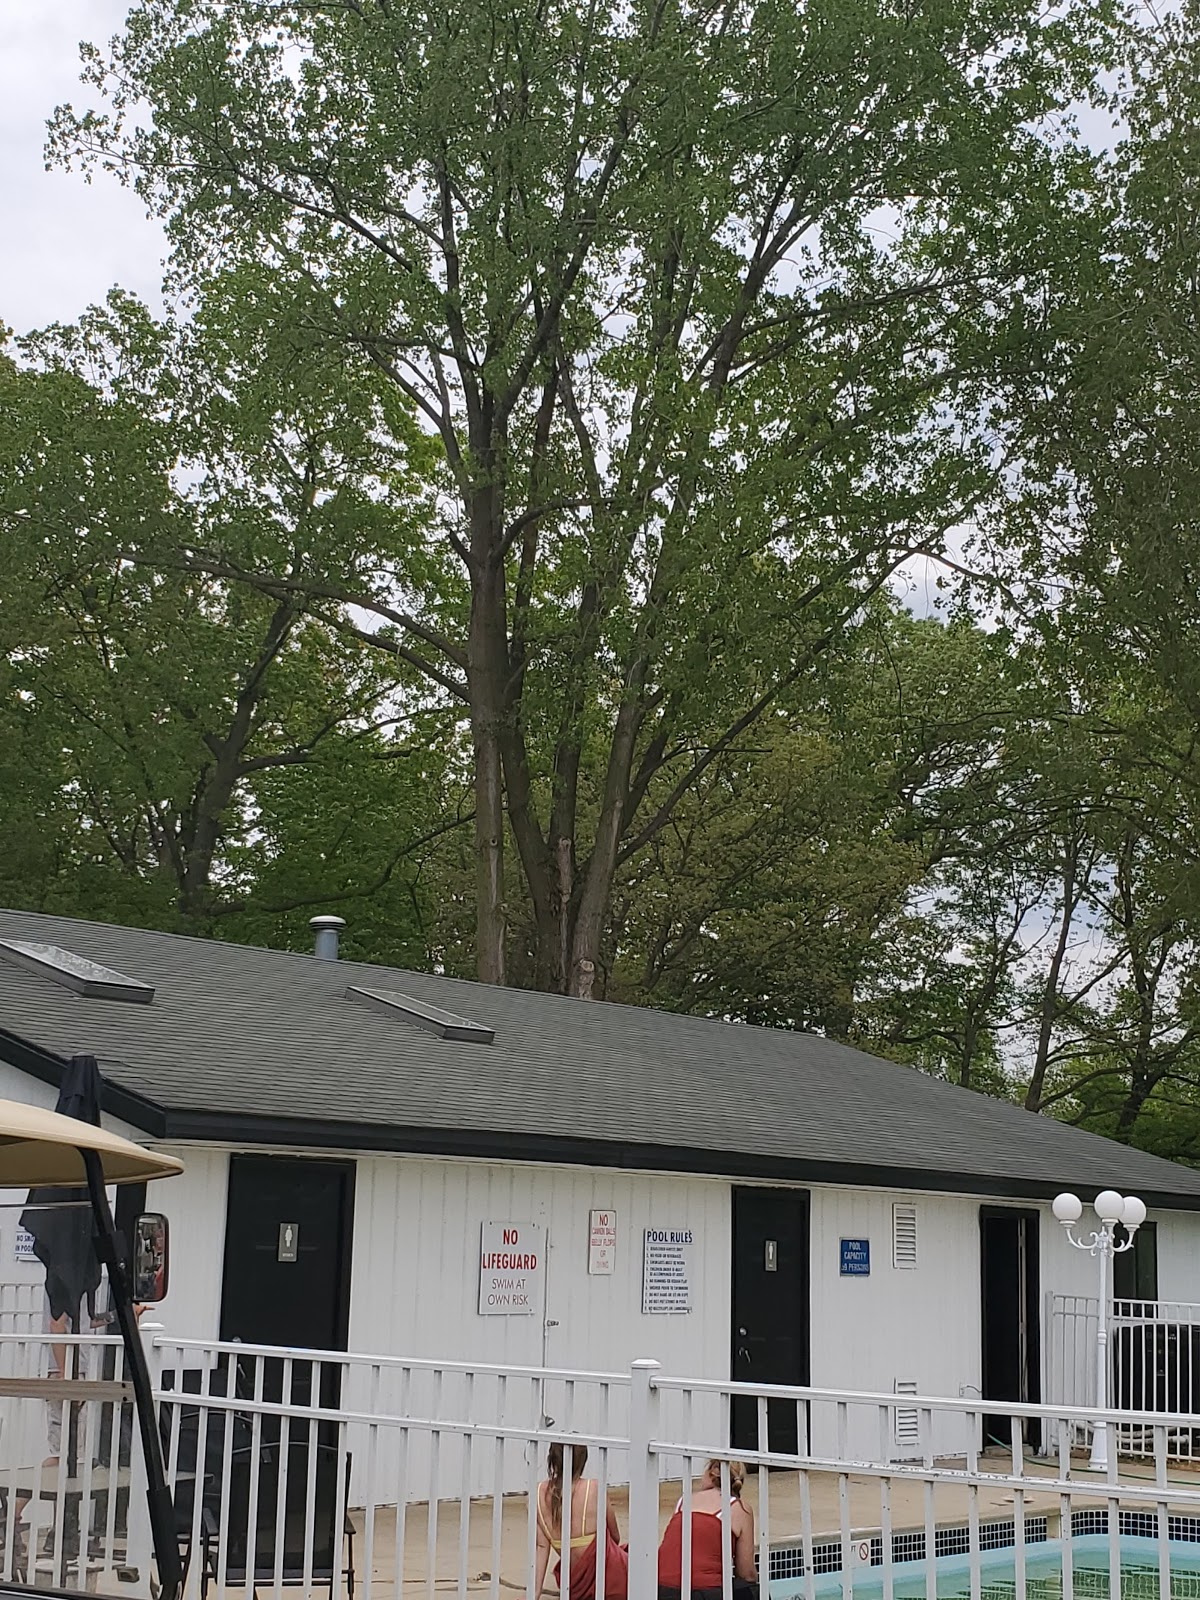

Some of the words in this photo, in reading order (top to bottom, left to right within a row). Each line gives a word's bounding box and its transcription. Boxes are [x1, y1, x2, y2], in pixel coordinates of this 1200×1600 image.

[599, 1214, 608, 1226] NO
[503, 1229, 518, 1245] NO
[647, 1231, 668, 1242] POOL
[670, 1231, 692, 1243] RULES
[21, 1244, 33, 1252] POO
[849, 1242, 861, 1250] POOL
[482, 1253, 537, 1270] LIFEGUARD
[492, 1278, 514, 1290] SWIM
[516, 1279, 526, 1289] AT
[487, 1294, 510, 1305] OWN
[512, 1294, 528, 1305] RISK
